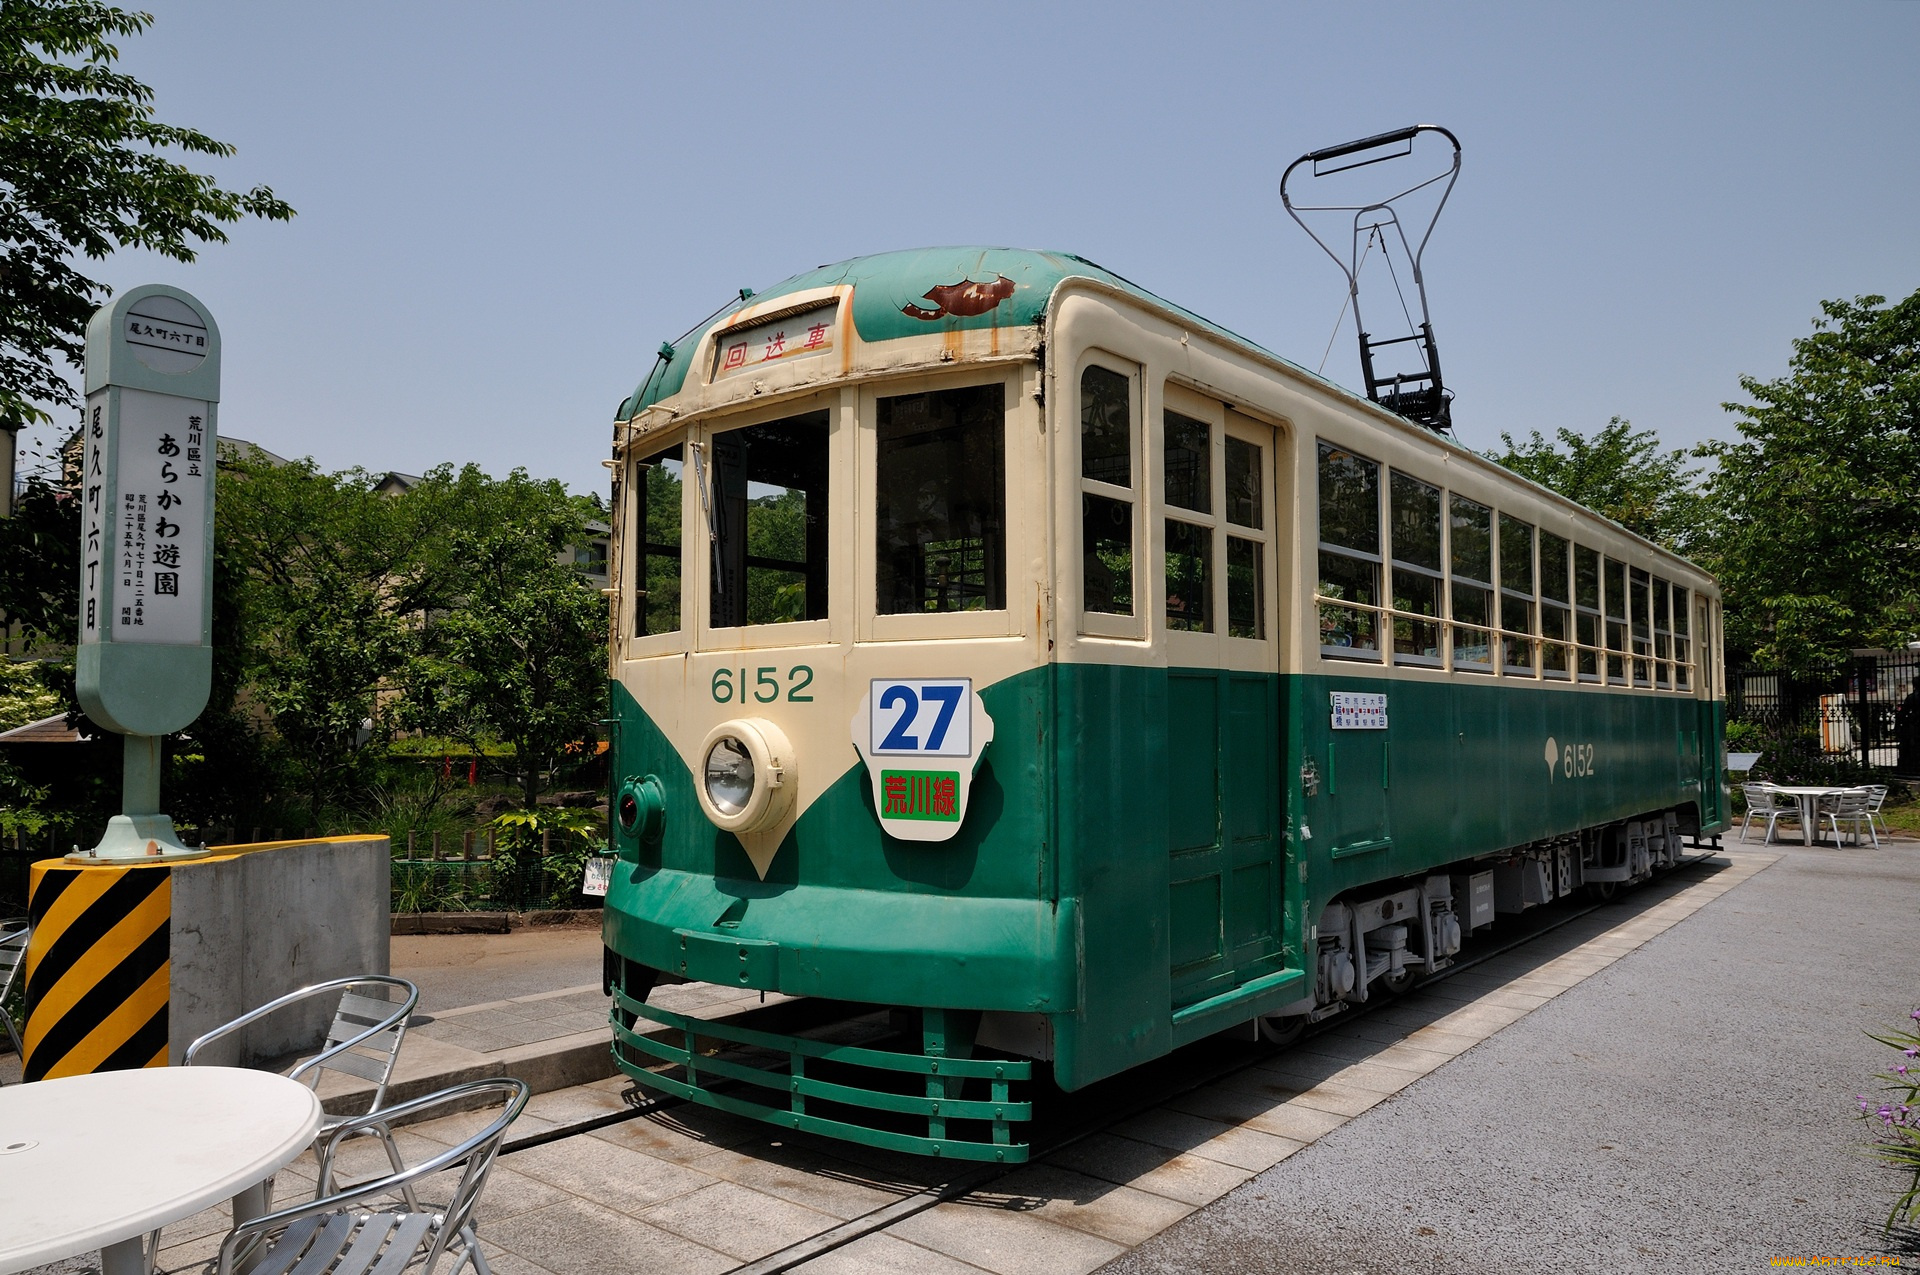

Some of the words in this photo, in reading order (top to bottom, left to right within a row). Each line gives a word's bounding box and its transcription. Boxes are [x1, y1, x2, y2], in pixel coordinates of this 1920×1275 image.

[129, 322, 205, 348] 尾久町六丁目
[723, 322, 830, 371] 回送車
[86, 405, 103, 630] 尾久町六丁目
[152, 432, 182, 598] あらかわ遊園
[711, 665, 814, 704] 6152
[878, 684, 964, 751] 27
[1564, 743, 1594, 779] 6152
[884, 775, 957, 817] 荒川線
